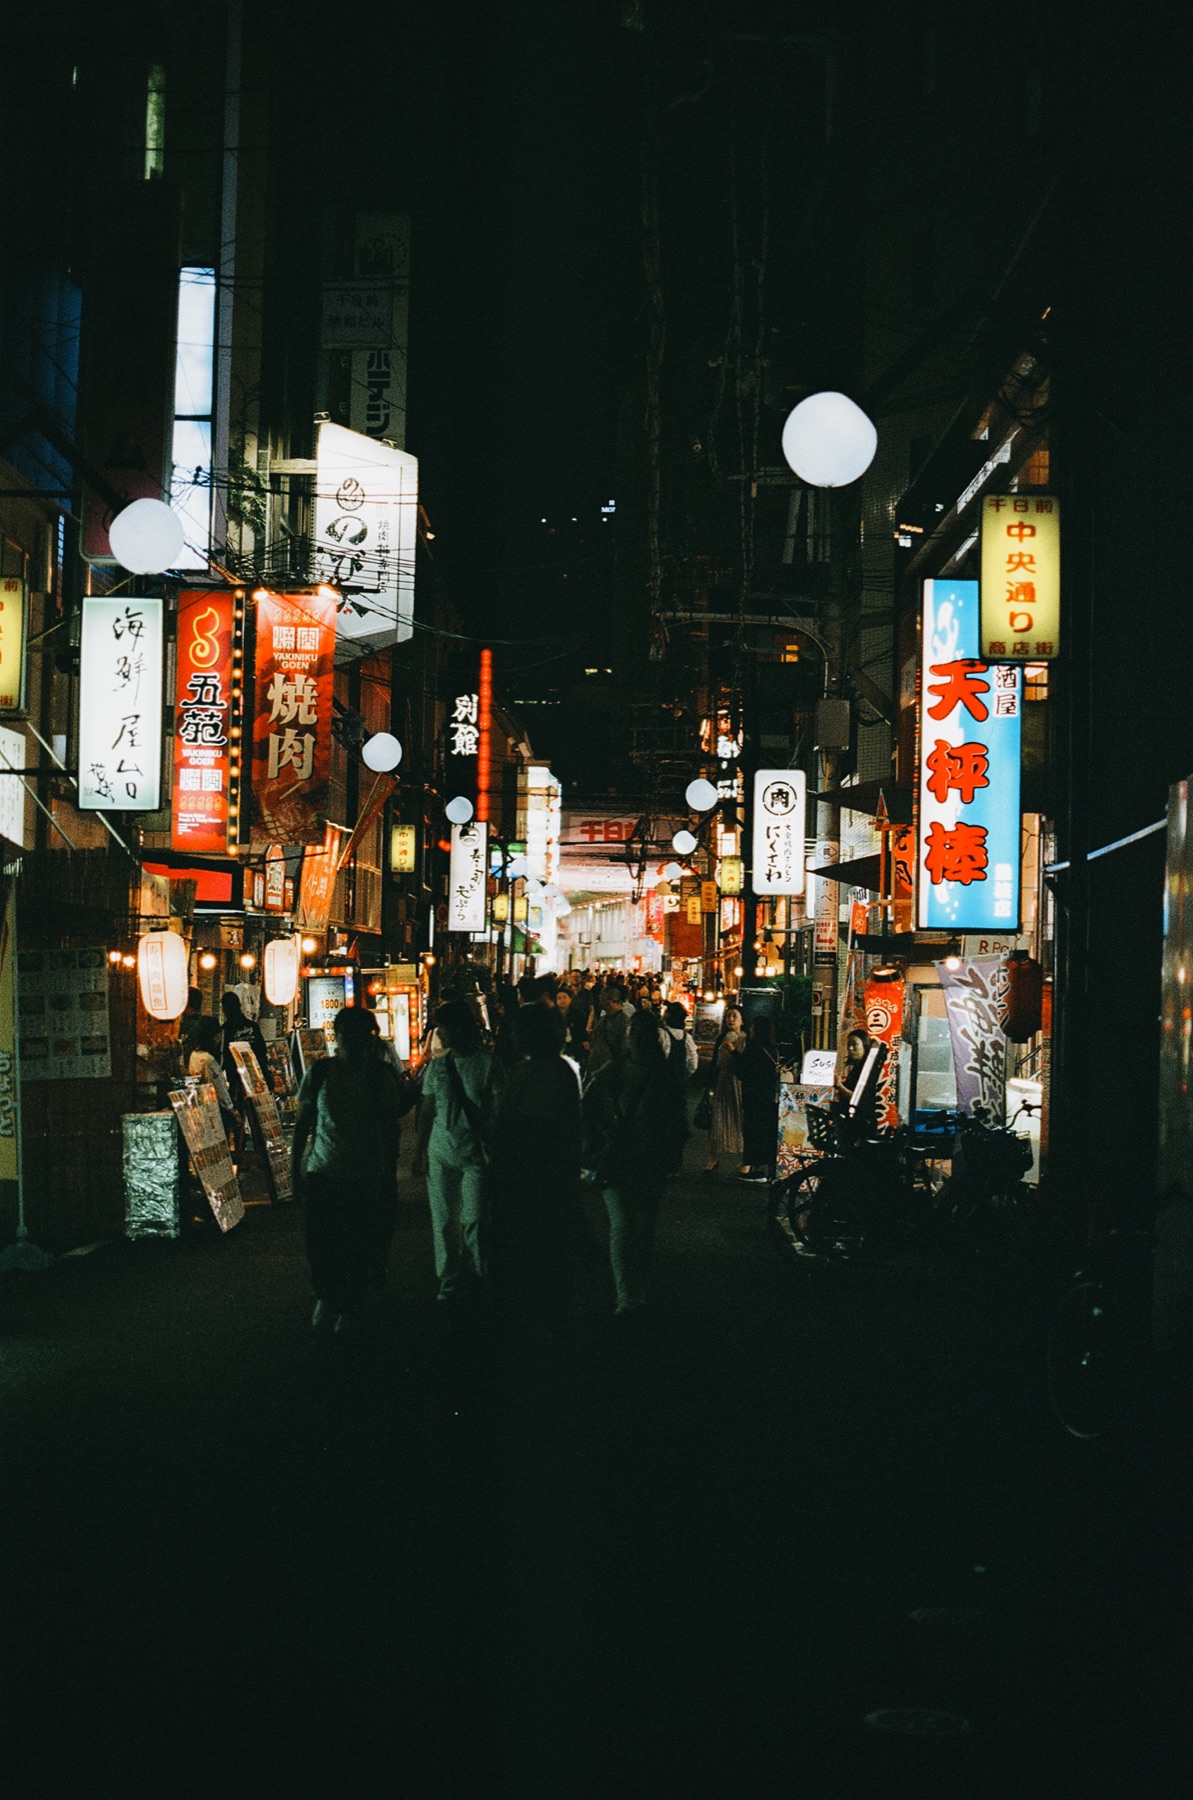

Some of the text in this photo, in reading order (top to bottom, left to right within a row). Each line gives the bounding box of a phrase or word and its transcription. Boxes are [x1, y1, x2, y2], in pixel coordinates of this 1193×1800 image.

[989, 499, 1054, 514] 千日前
[1005, 521, 1037, 634] 中央通り
[273, 653, 318, 661] YAKINIKU
[281, 661, 309, 669] GOEN
[988, 641, 1054, 656] 商店街
[180, 672, 228, 746] 五苑
[996, 666, 1017, 715] 酒屋
[266, 672, 318, 780] 焼肉
[450, 694, 480, 756] 別館
[182, 749, 222, 758] YAKINIKU
[189, 757, 215, 766] GOEN
[925, 658, 990, 887] 天秤棒
[765, 825, 782, 883] にくさわ
